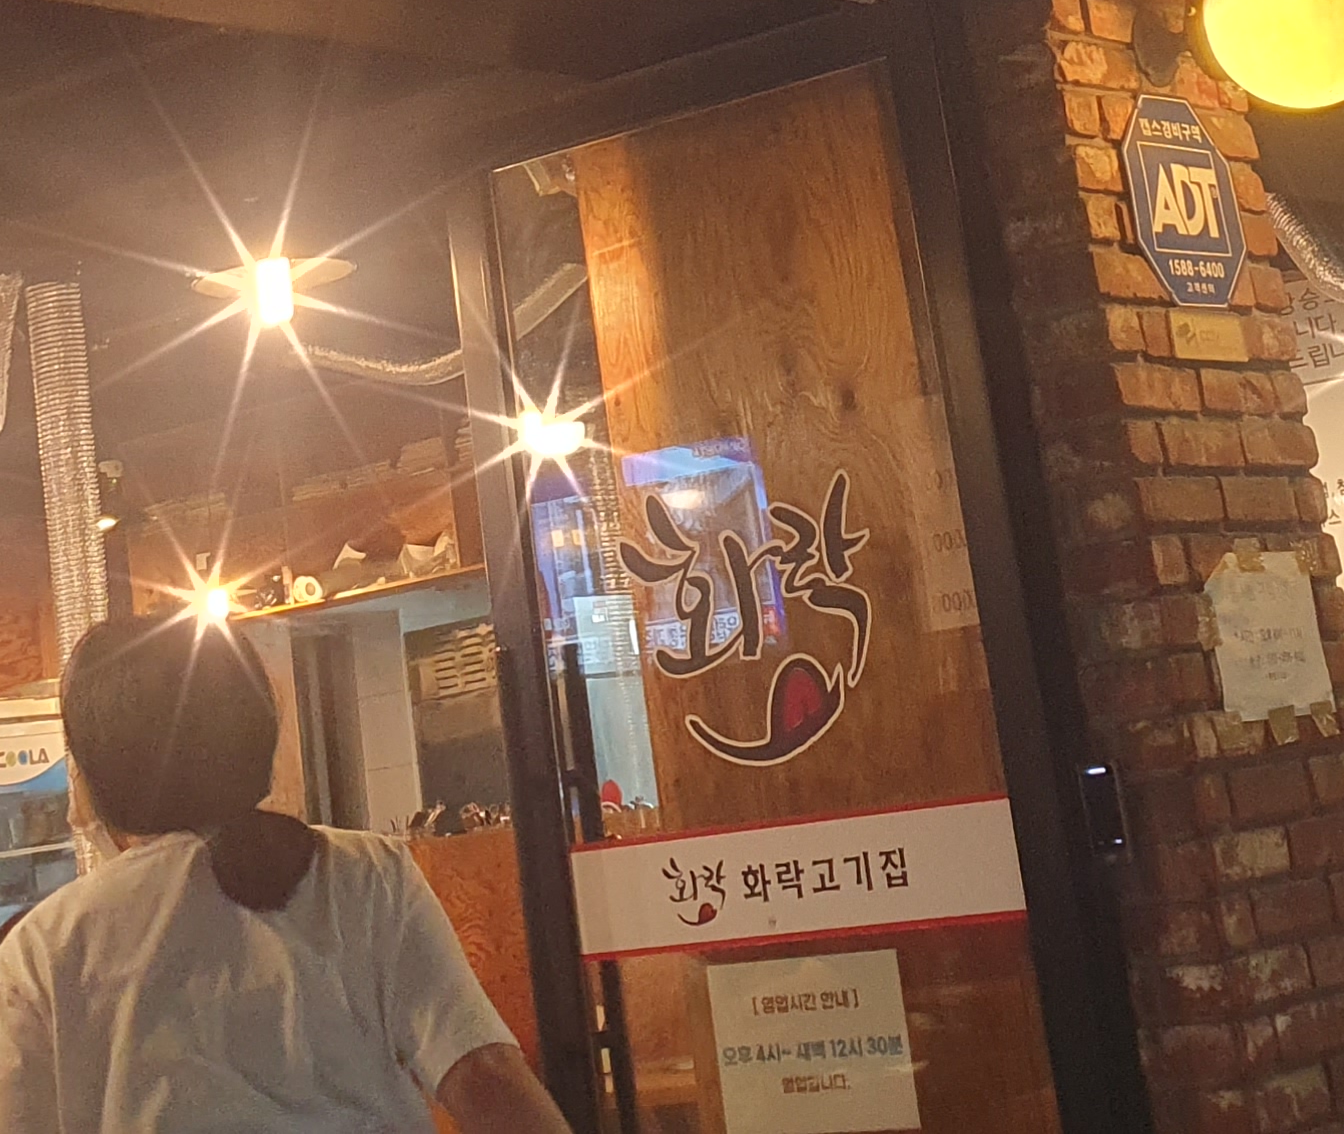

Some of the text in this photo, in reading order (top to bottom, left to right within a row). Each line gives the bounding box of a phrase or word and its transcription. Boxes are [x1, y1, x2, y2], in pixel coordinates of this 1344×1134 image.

[1154, 162, 1220, 239] ADT
[1168, 258, 1226, 279] 1588-6400
[741, 847, 909, 903] 화락고기집
